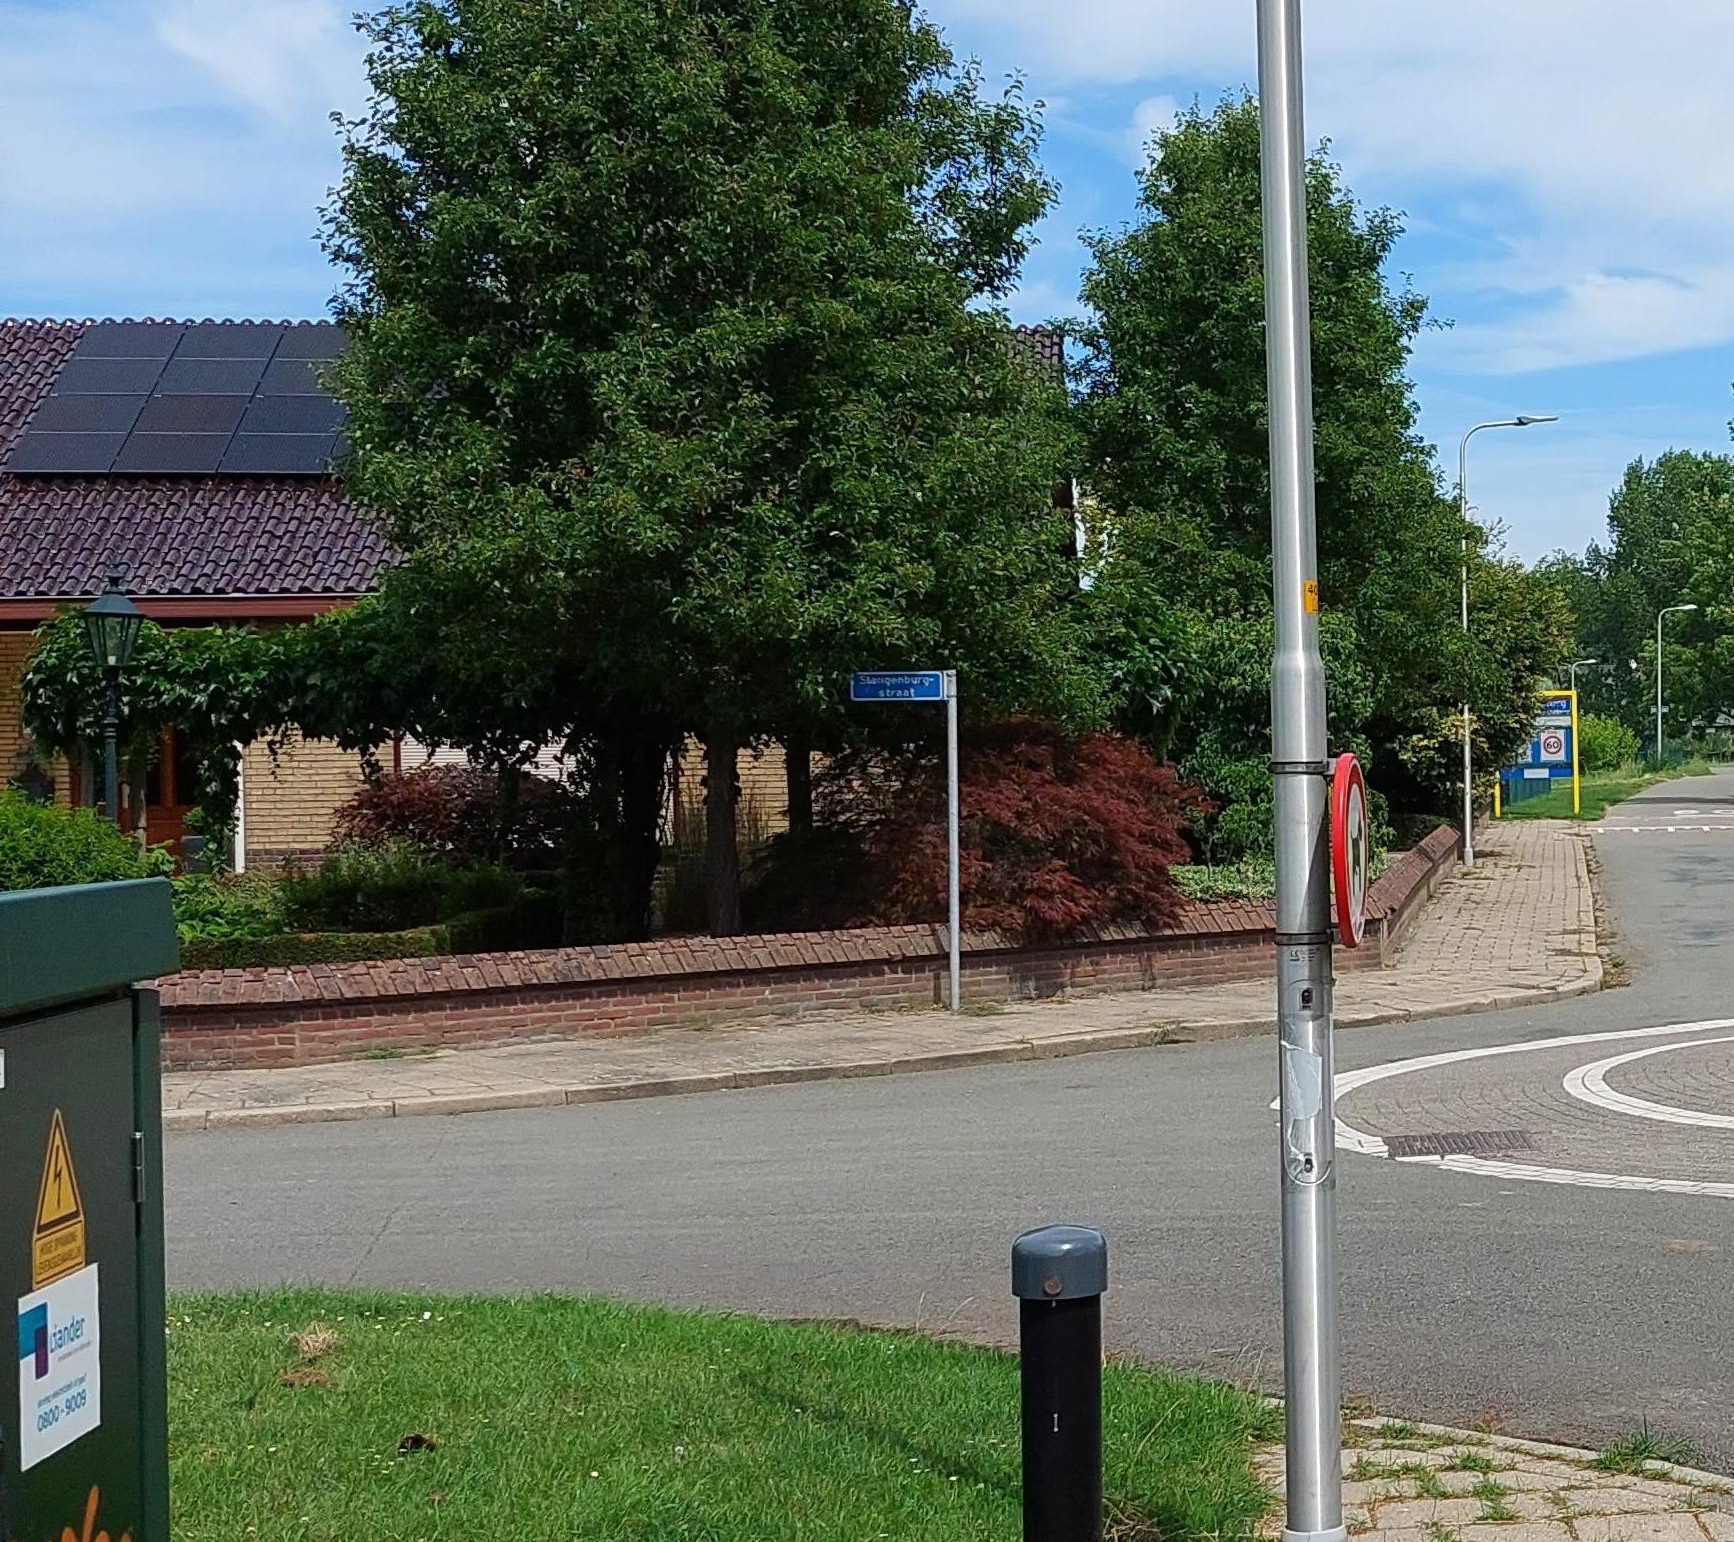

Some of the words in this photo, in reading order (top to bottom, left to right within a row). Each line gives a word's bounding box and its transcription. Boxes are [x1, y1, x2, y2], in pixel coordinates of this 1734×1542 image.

[878, 687, 916, 698] straat
[1546, 740, 1559, 750] 60
[50, 1316, 85, 1353] Liander
